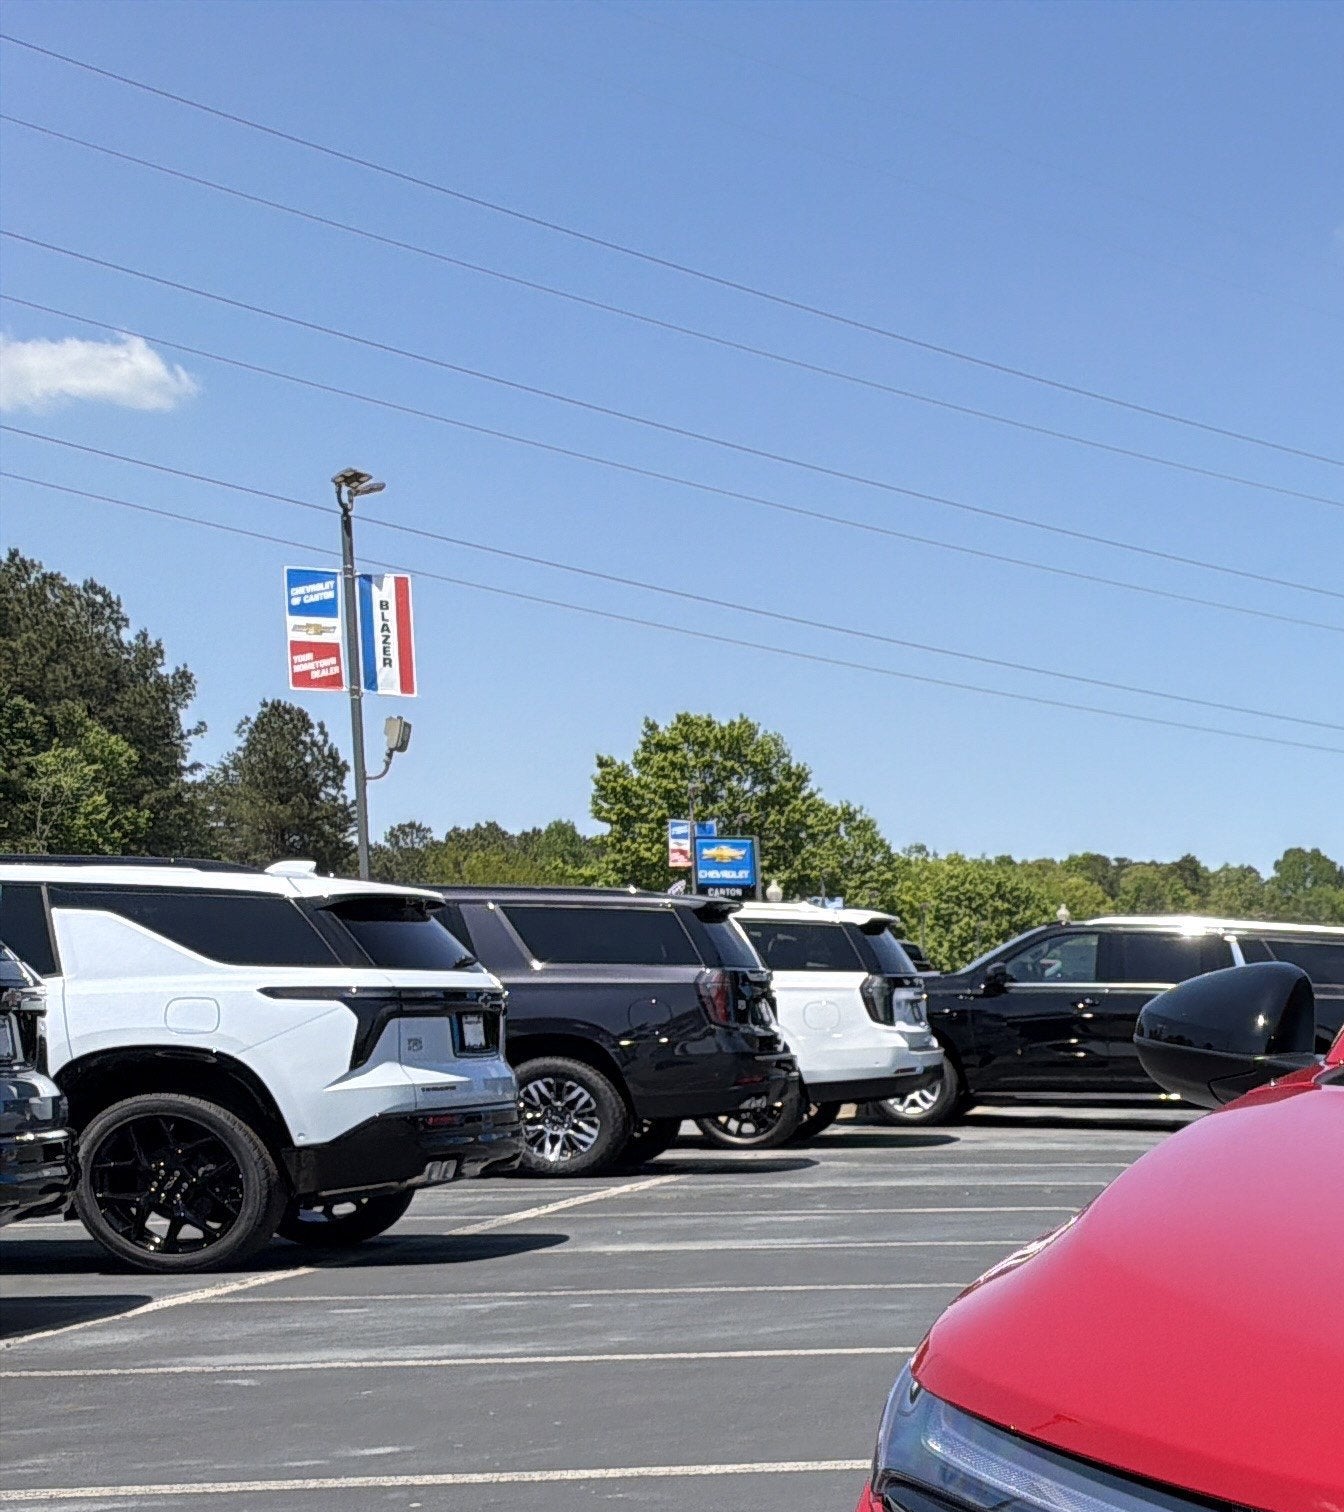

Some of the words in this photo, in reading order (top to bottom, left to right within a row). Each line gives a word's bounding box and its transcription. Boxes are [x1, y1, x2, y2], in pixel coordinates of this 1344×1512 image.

[290, 580, 336, 597] CHEVROLET
[290, 596, 302, 606] OF
[302, 589, 335, 604] CANTON
[379, 599, 393, 669] BLAZER
[292, 652, 314, 664] YOUR
[707, 887, 743, 897] CANTON
